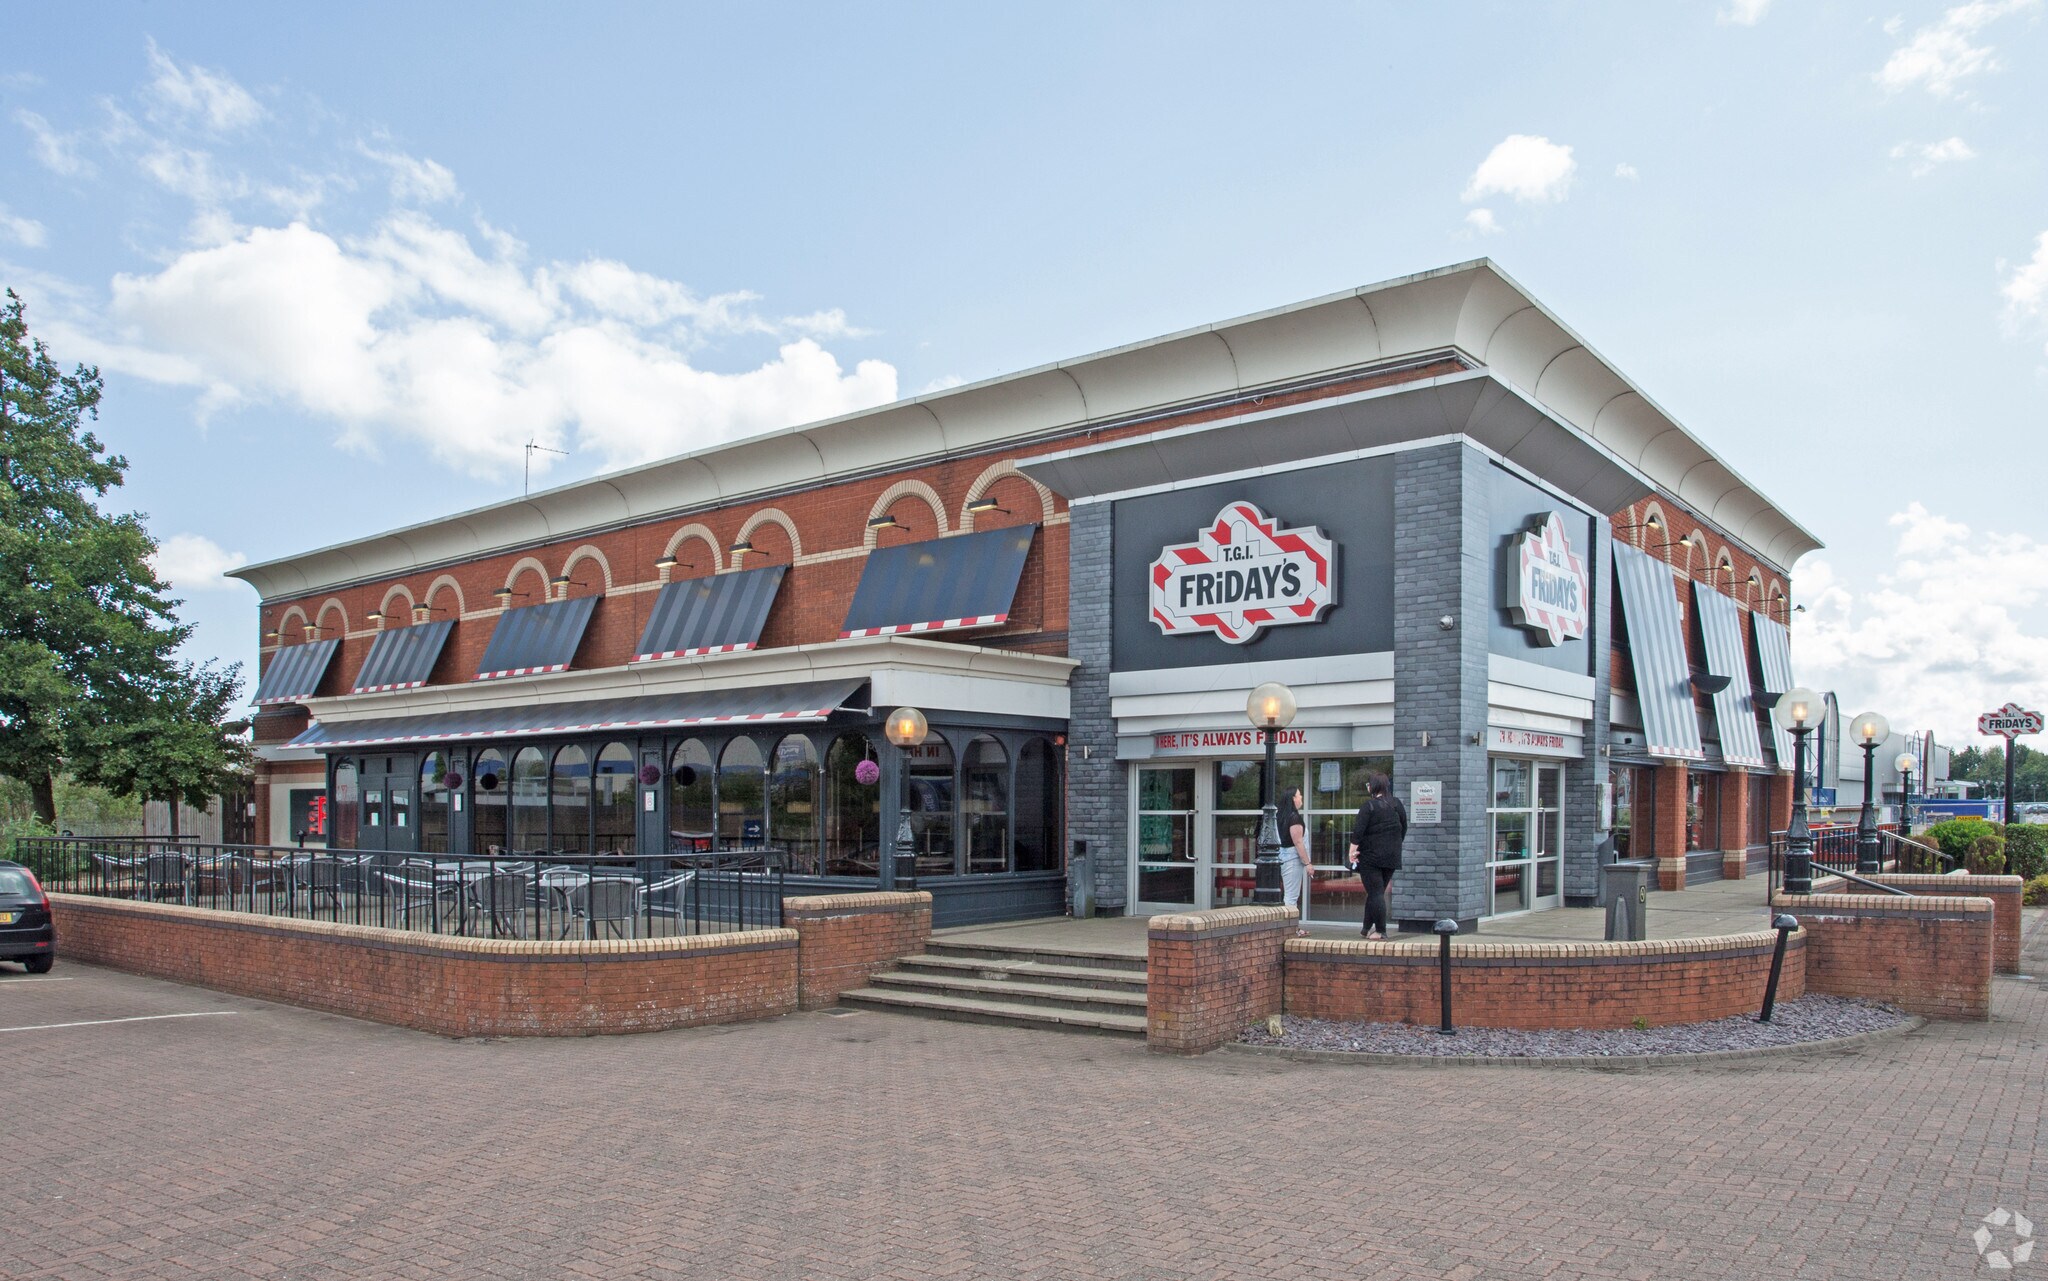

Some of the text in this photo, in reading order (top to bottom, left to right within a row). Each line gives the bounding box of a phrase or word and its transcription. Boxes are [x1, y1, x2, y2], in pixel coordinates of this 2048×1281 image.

[1223, 545, 1253, 562] T.G.I.
[1549, 550, 1561, 568] T.G.I.
[1180, 558, 1301, 608] FRiDAY'S
[1159, 734, 1179, 749] HERE,
[1181, 733, 1199, 748] IT'S
[1202, 731, 1252, 746] ALWAYS
